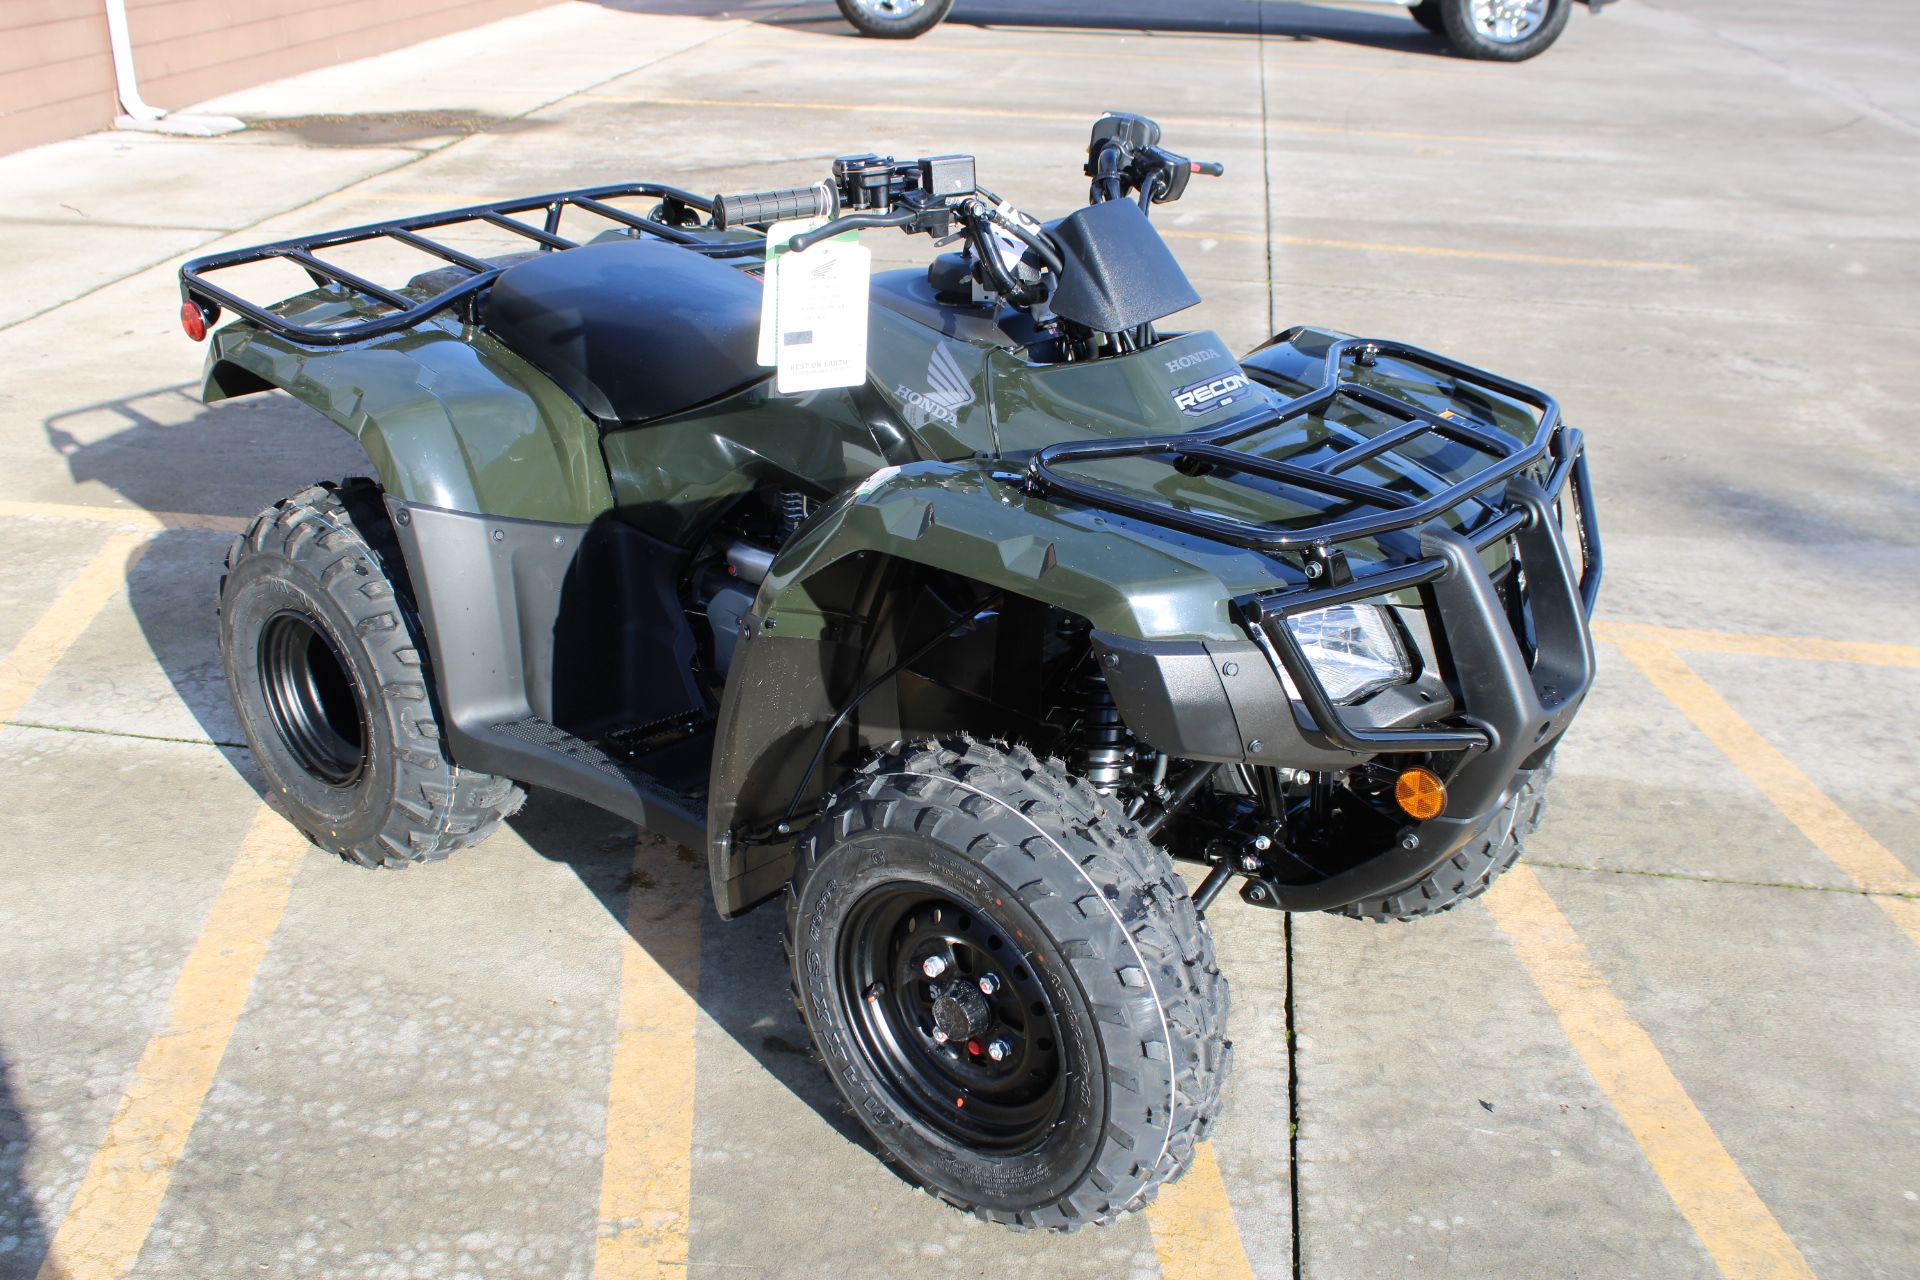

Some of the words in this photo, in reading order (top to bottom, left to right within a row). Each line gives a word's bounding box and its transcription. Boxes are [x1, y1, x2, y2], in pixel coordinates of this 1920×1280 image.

[1165, 349, 1221, 373] HONDA
[894, 384, 958, 428] HONDA
[1173, 373, 1250, 411] RECON
[805, 948, 896, 1128] MAXXIS
